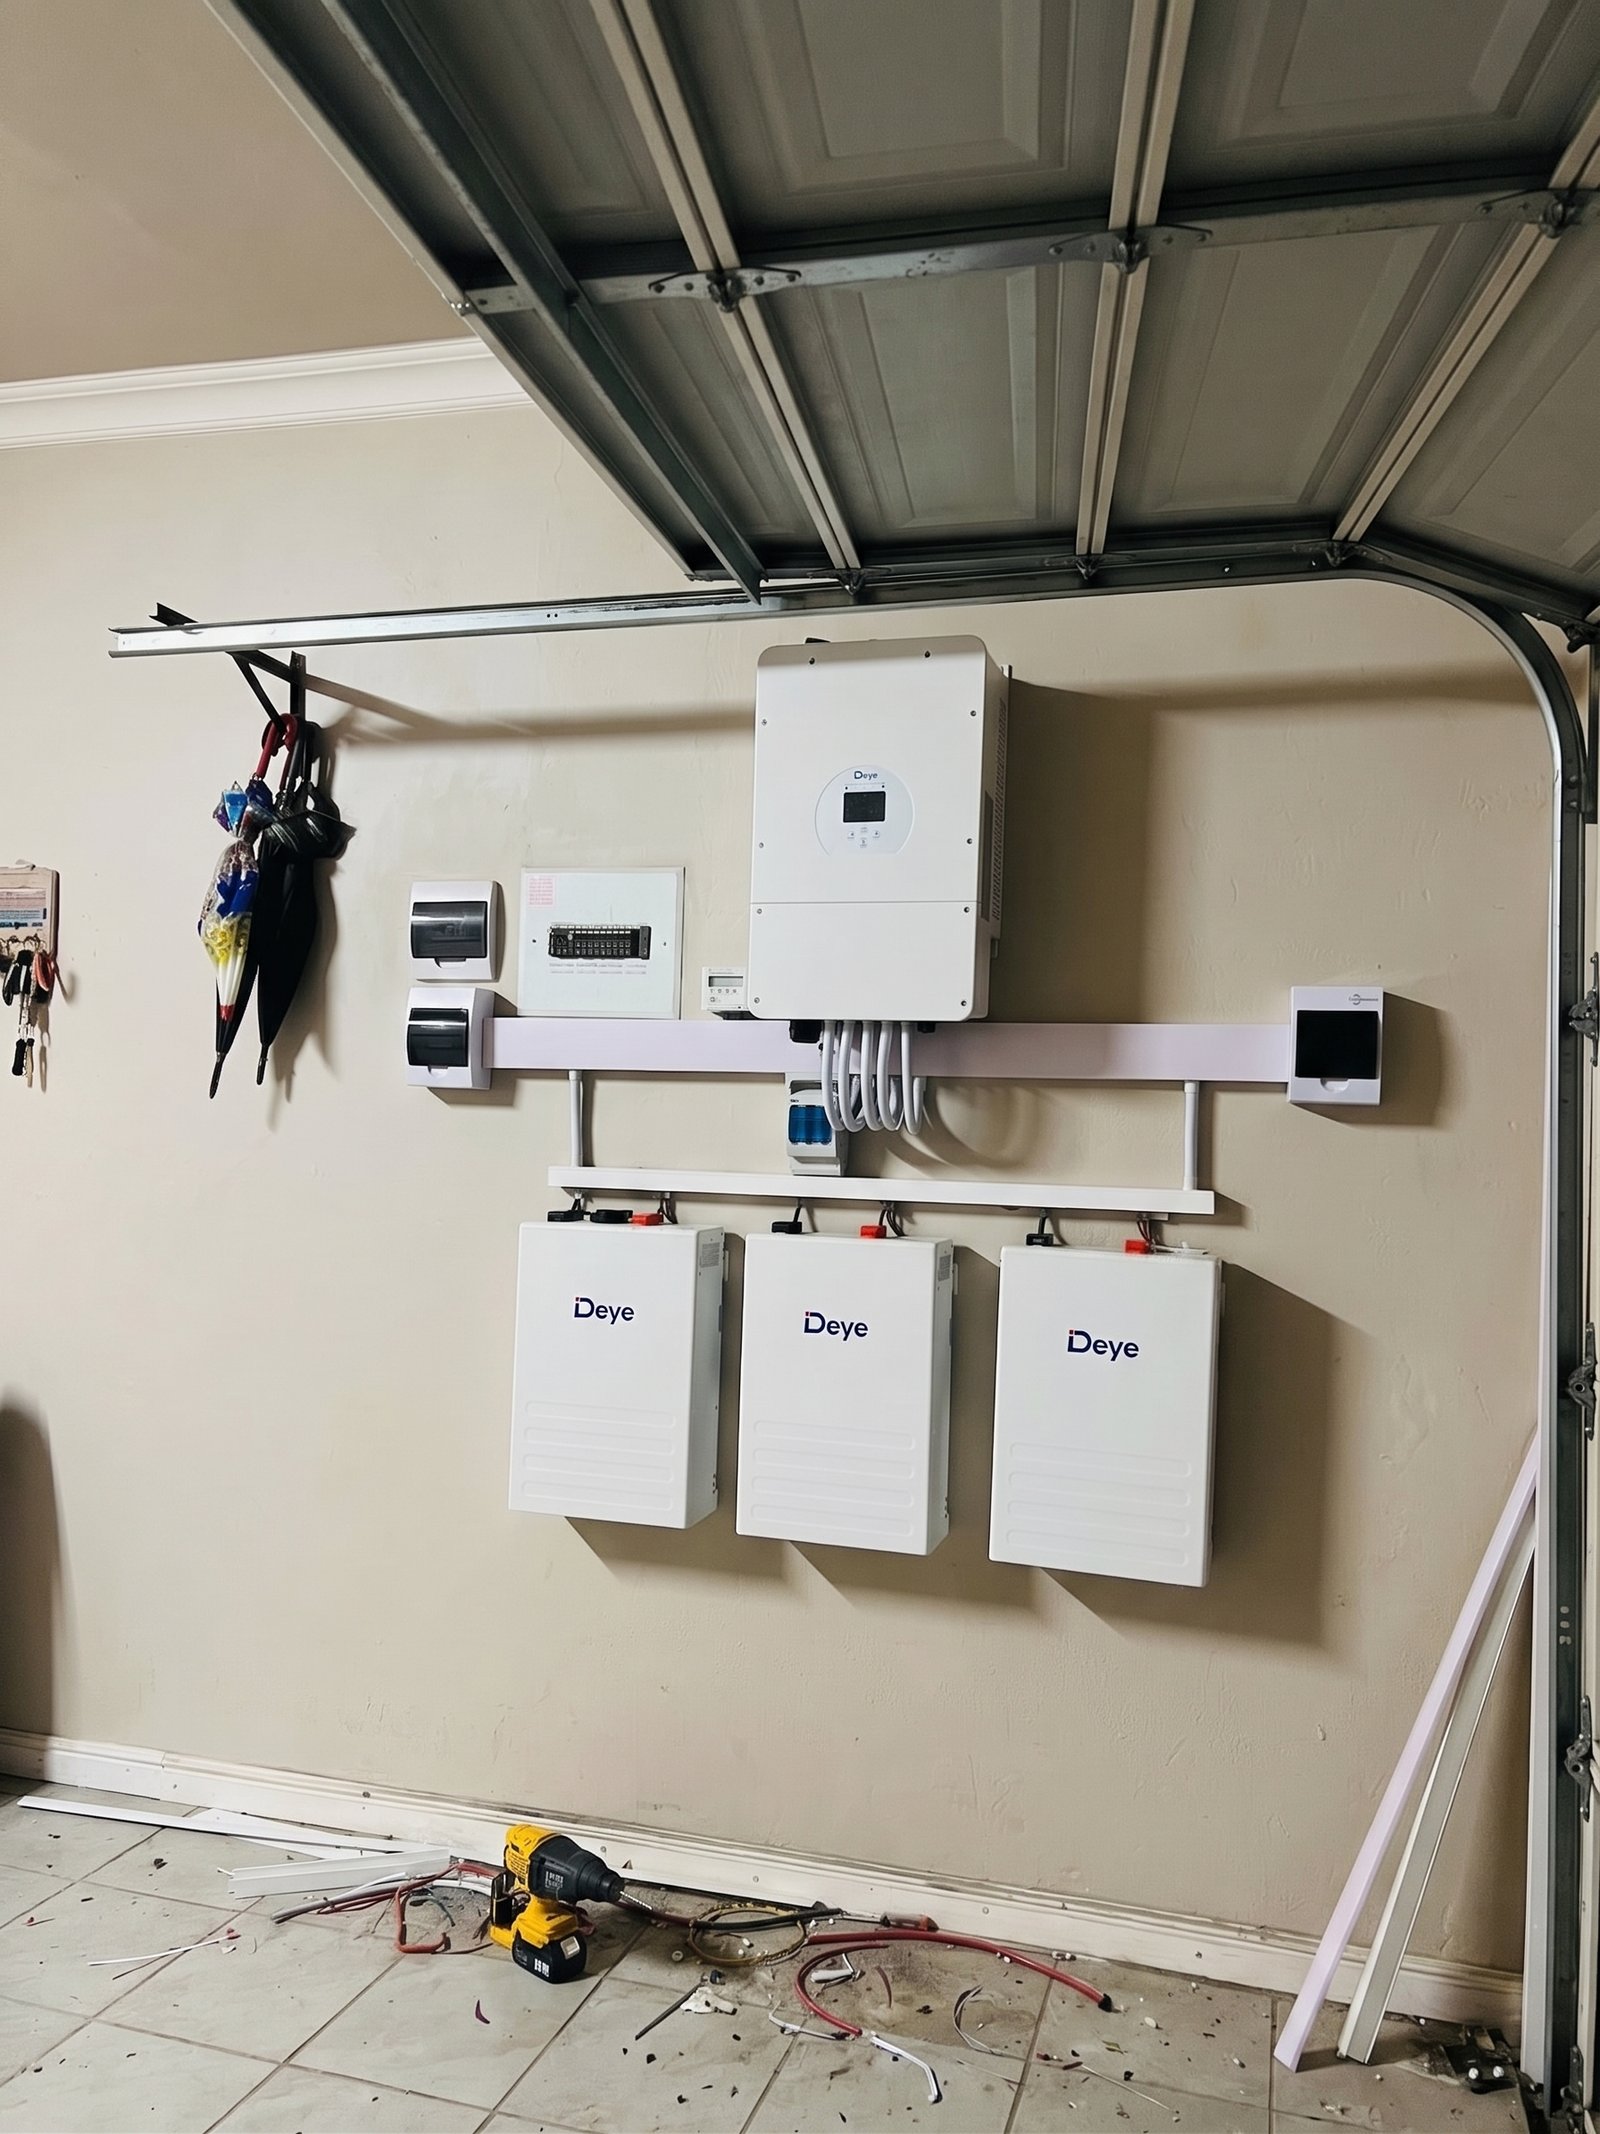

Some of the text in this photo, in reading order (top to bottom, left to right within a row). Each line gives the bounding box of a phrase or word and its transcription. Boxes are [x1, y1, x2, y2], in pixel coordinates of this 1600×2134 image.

[574, 1297, 635, 1325] Deye
[804, 1311, 869, 1341] Deye
[1067, 1329, 1140, 1361] Deye
